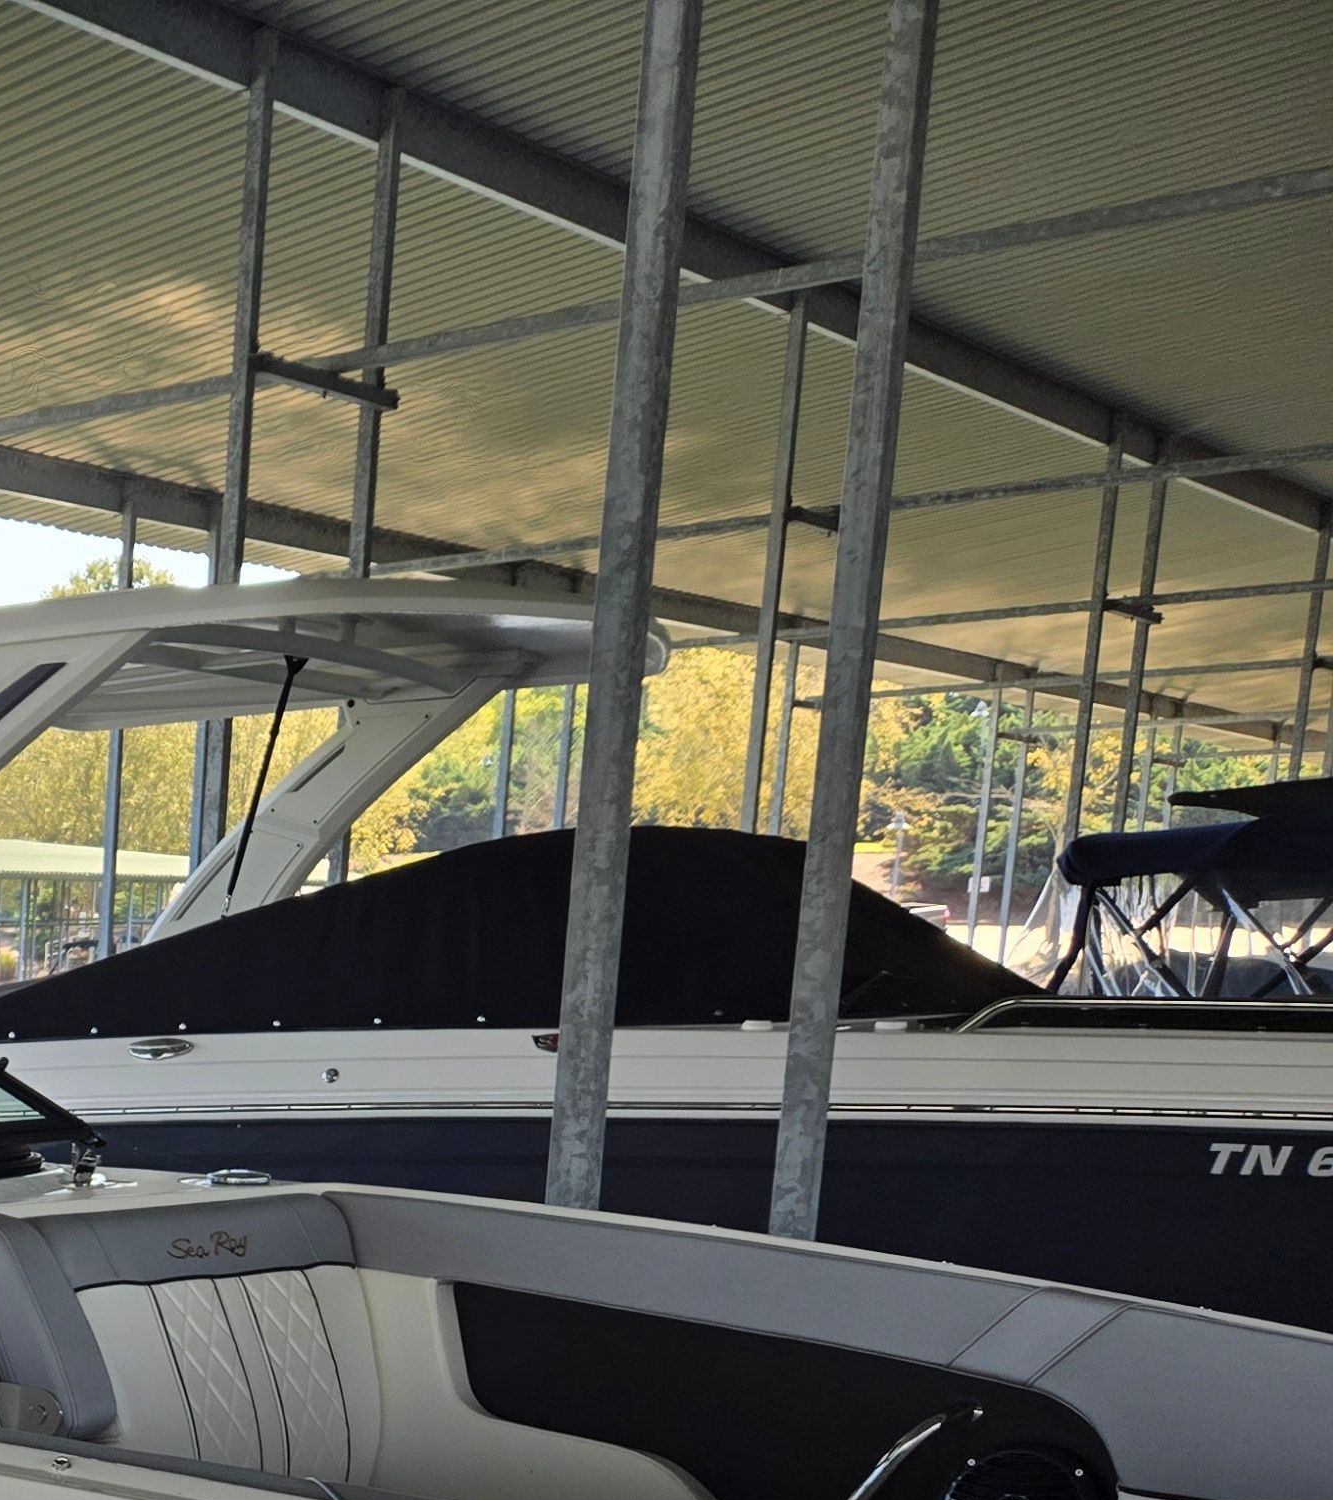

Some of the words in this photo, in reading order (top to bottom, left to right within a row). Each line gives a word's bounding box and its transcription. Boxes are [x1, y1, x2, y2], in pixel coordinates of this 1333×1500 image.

[1209, 1142, 1294, 1176] TN
[166, 1237, 210, 1259] Sea
[209, 1230, 247, 1257] Ray
